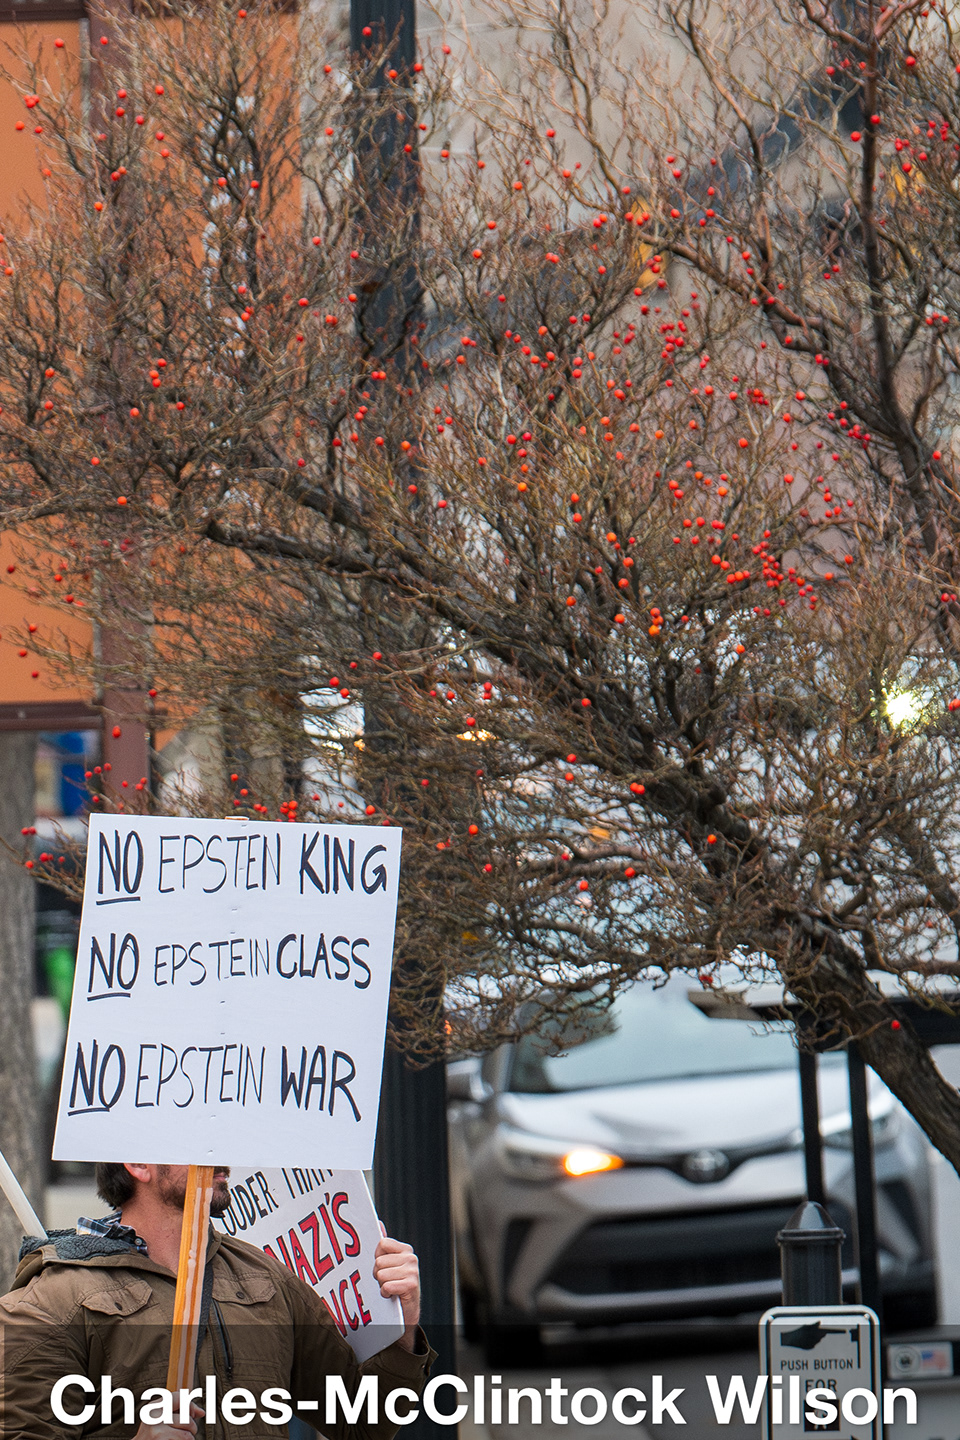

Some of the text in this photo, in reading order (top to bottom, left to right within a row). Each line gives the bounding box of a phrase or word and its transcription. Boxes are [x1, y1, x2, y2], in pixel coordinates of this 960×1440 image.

[97, 830, 388, 895] NO EPSTEN KING
[88, 932, 372, 992] NO EPSTEIN CLASS
[69, 1039, 362, 1122] NO EPSTEIN WAR
[780, 1358, 854, 1370] PUSH BUTTON
